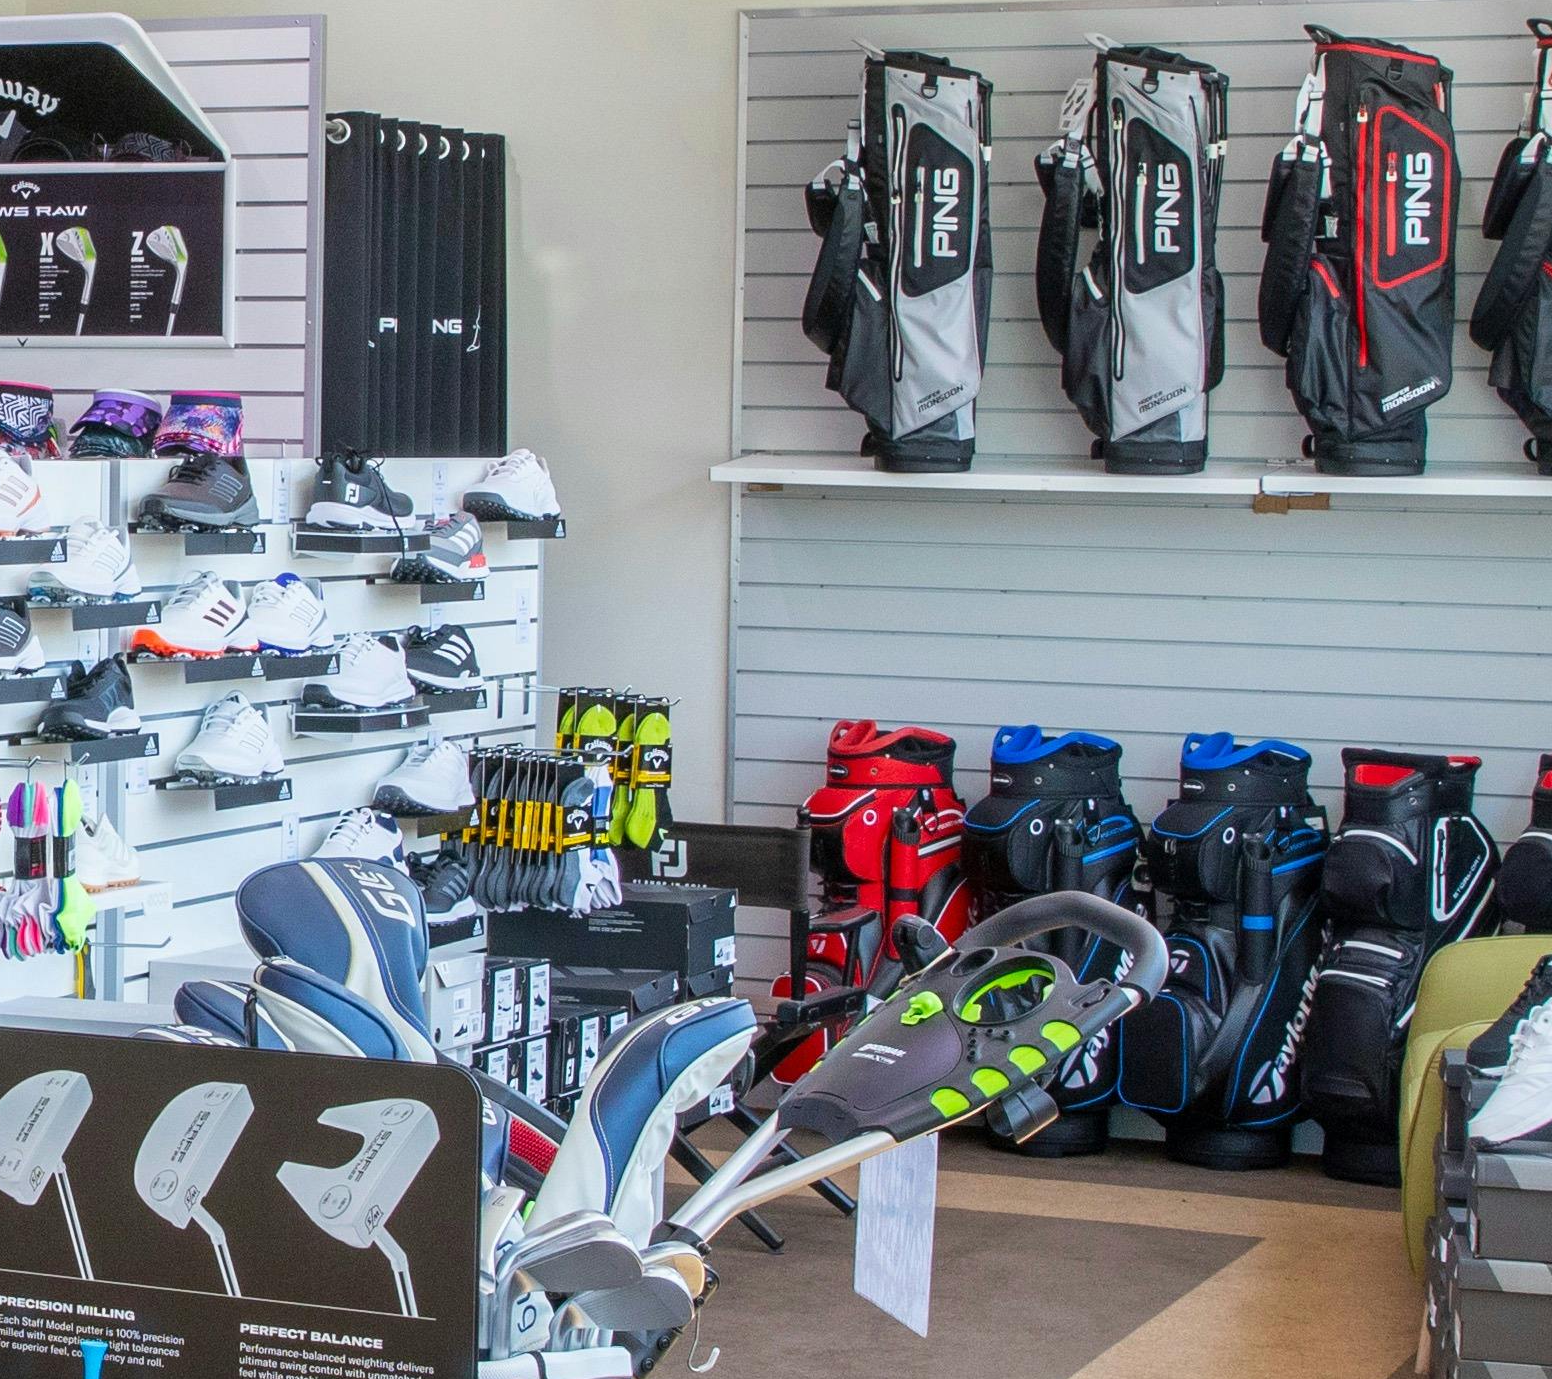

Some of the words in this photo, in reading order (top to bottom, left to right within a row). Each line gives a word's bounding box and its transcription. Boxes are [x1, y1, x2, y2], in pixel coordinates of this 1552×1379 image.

[11, 179, 41, 195] Callaway
[1404, 152, 1432, 246] PING
[34, 204, 88, 218] RAW
[932, 167, 959, 258] PING
[1154, 162, 1181, 254] PING
[40, 231, 54, 256] X
[131, 231, 144, 256] Z
[918, 384, 964, 413] MONSOON
[1138, 386, 1187, 414] MONSOON
[1382, 380, 1437, 413] MONSOON
[344, 482, 360, 504] FJ
[651, 838, 688, 878] FJ
[77, 1304, 136, 1320] MILLING
[21, 1317, 44, 1328] Staff
[46, 1319, 74, 1331] Model
[76, 1325, 104, 1337] putter
[106, 1326, 114, 1336] is
[116, 1328, 142, 1339] 100%
[143, 1333, 185, 1344] precision
[240, 1323, 308, 1339] PERFECT
[310, 1331, 384, 1348] BALANCE
[239, 1355, 278, 1367] ultimate
[280, 1361, 308, 1373] swing
[309, 1365, 343, 1375] control
[345, 1368, 366, 1378] with
[240, 1342, 346, 1363] Performance-balanced
[348, 1357, 395, 1371] weighting
[396, 1361, 435, 1374] delivers
